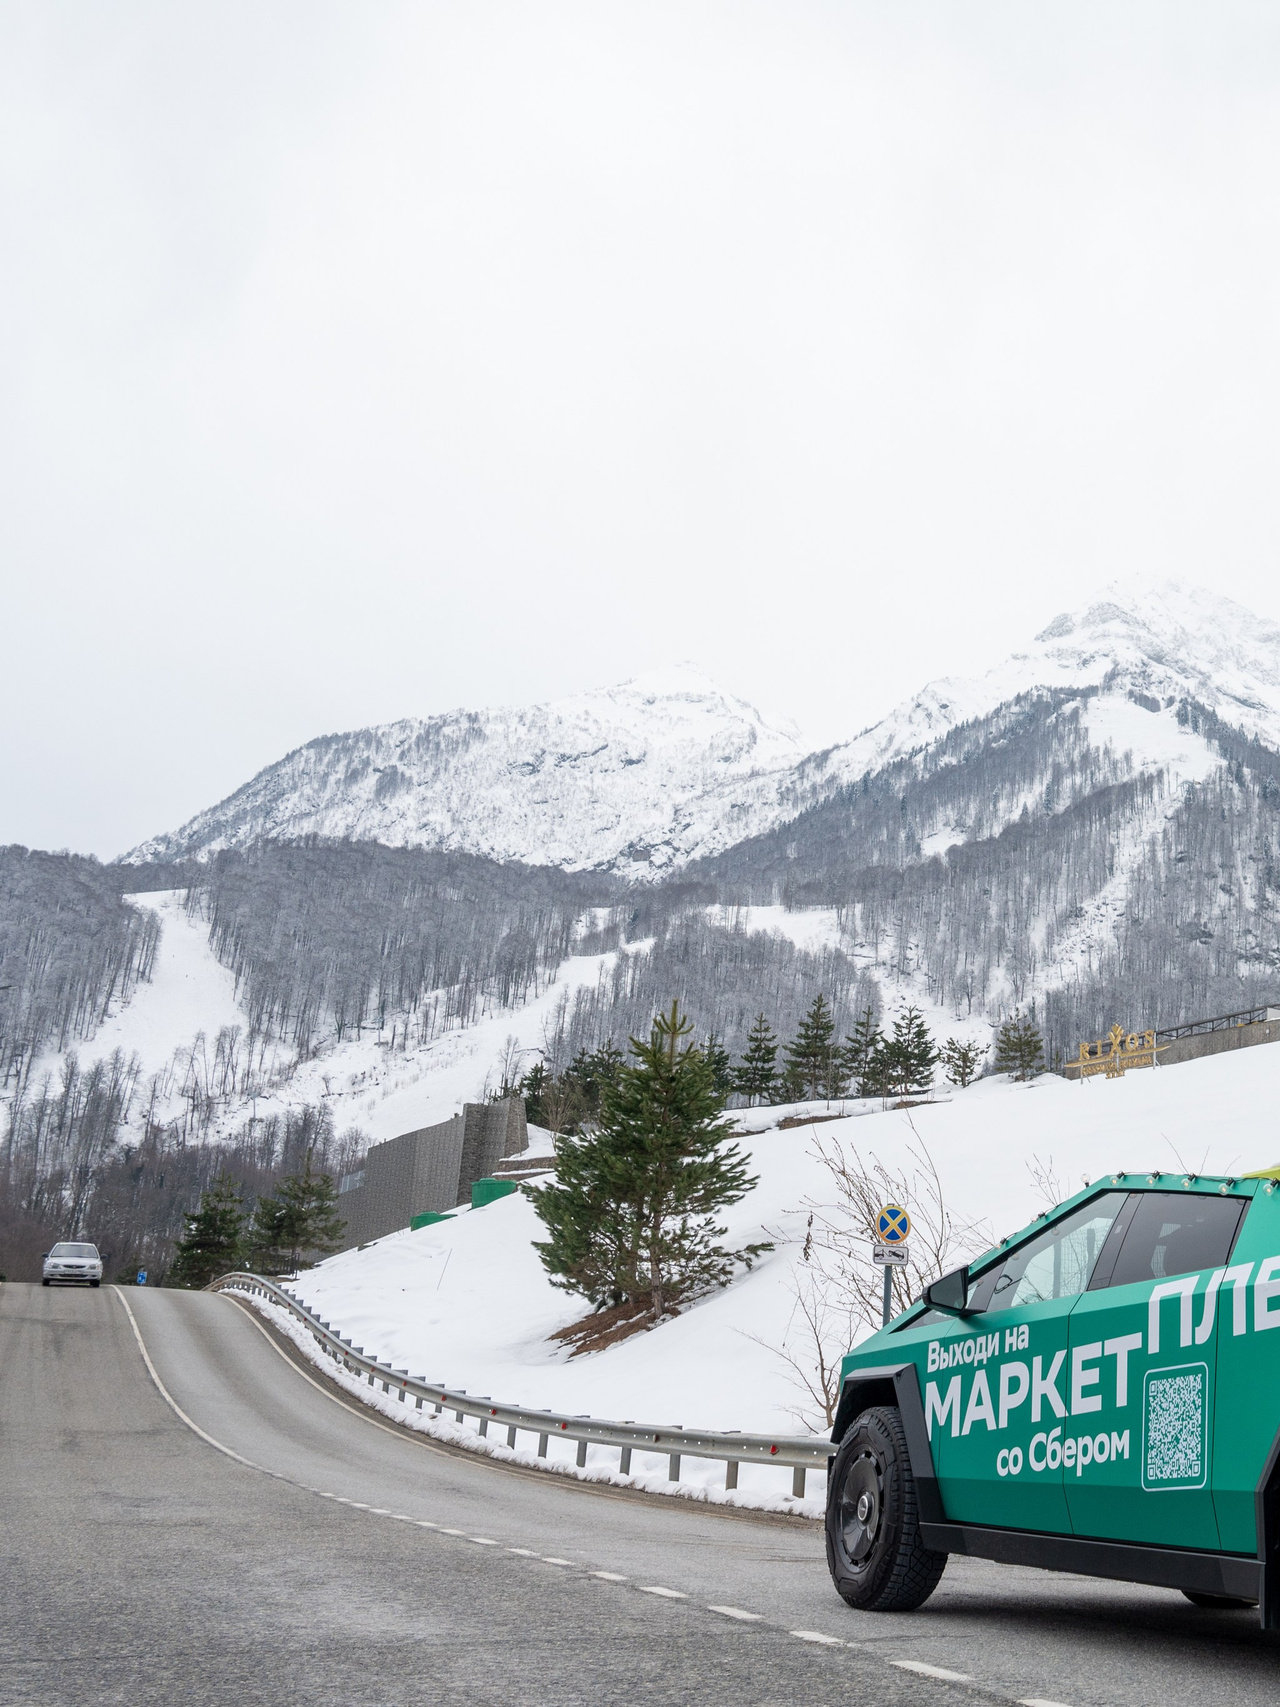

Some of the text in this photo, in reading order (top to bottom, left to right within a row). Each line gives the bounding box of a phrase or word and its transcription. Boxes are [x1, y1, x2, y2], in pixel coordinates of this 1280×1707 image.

[1079, 1028, 1154, 1060] RIXOS
[927, 1324, 1029, 1373] Выходи на
[996, 1426, 1130, 1477] со Сбером
